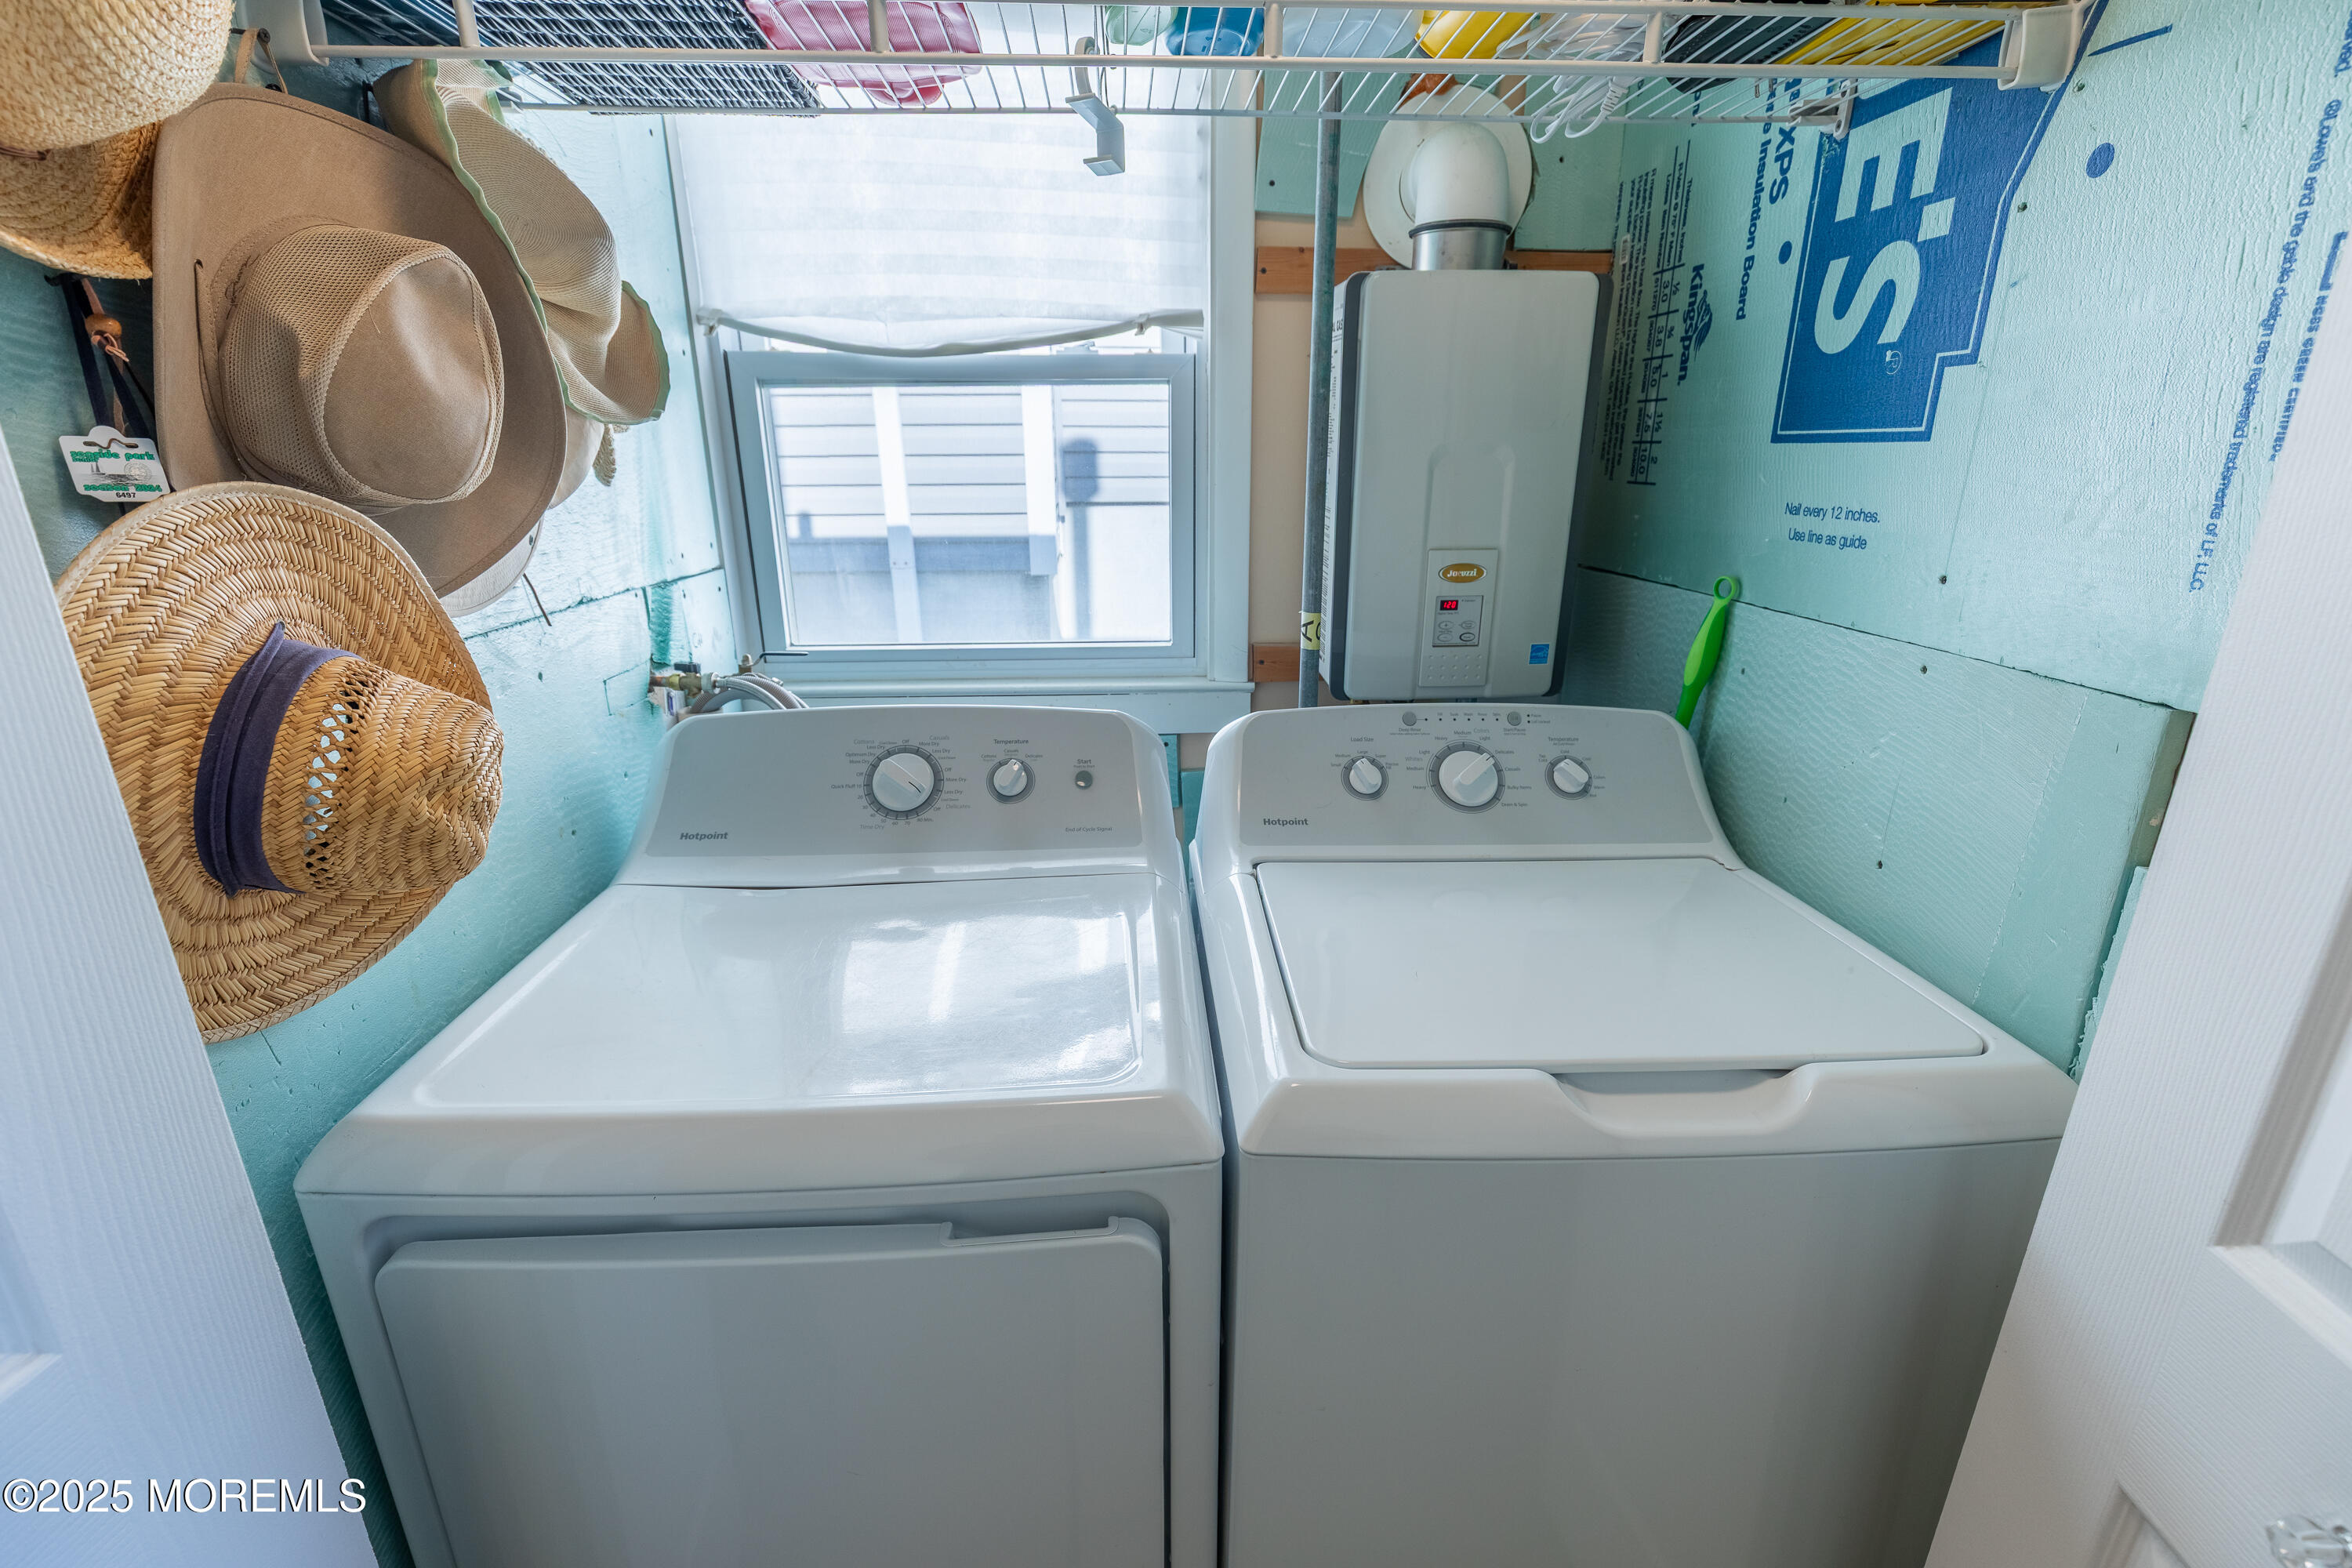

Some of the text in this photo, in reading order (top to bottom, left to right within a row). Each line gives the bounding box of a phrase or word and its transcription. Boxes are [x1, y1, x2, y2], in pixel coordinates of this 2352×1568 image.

[1769, 126, 1797, 205] XPS
[1746, 138, 1772, 250] Insulation
[2299, 176, 2318, 209] and
[2290, 211, 2308, 237] the
[2277, 240, 2299, 284] gable
[1661, 279, 1670, 302] 3.0
[1736, 254, 1755, 321] Board
[2260, 286, 2288, 338] design
[1655, 325, 1664, 348] 3.8
[2254, 340, 2270, 365] are
[1650, 366, 1659, 387] 5.0
[2234, 366, 2263, 439] registered
[70, 449, 155, 461] seaside park
[1639, 449, 1648, 474] 10.0
[2210, 441, 2243, 521] trademarks
[1785, 502, 1880, 523] Nail every 12 inches.
[1789, 528, 1867, 550] Use line as guide
[2202, 523, 2218, 538] of
[1447, 569, 1477, 577] Jacuzzi
[1263, 818, 1308, 827] Hotpoint
[680, 831, 728, 841] Hotpoint
